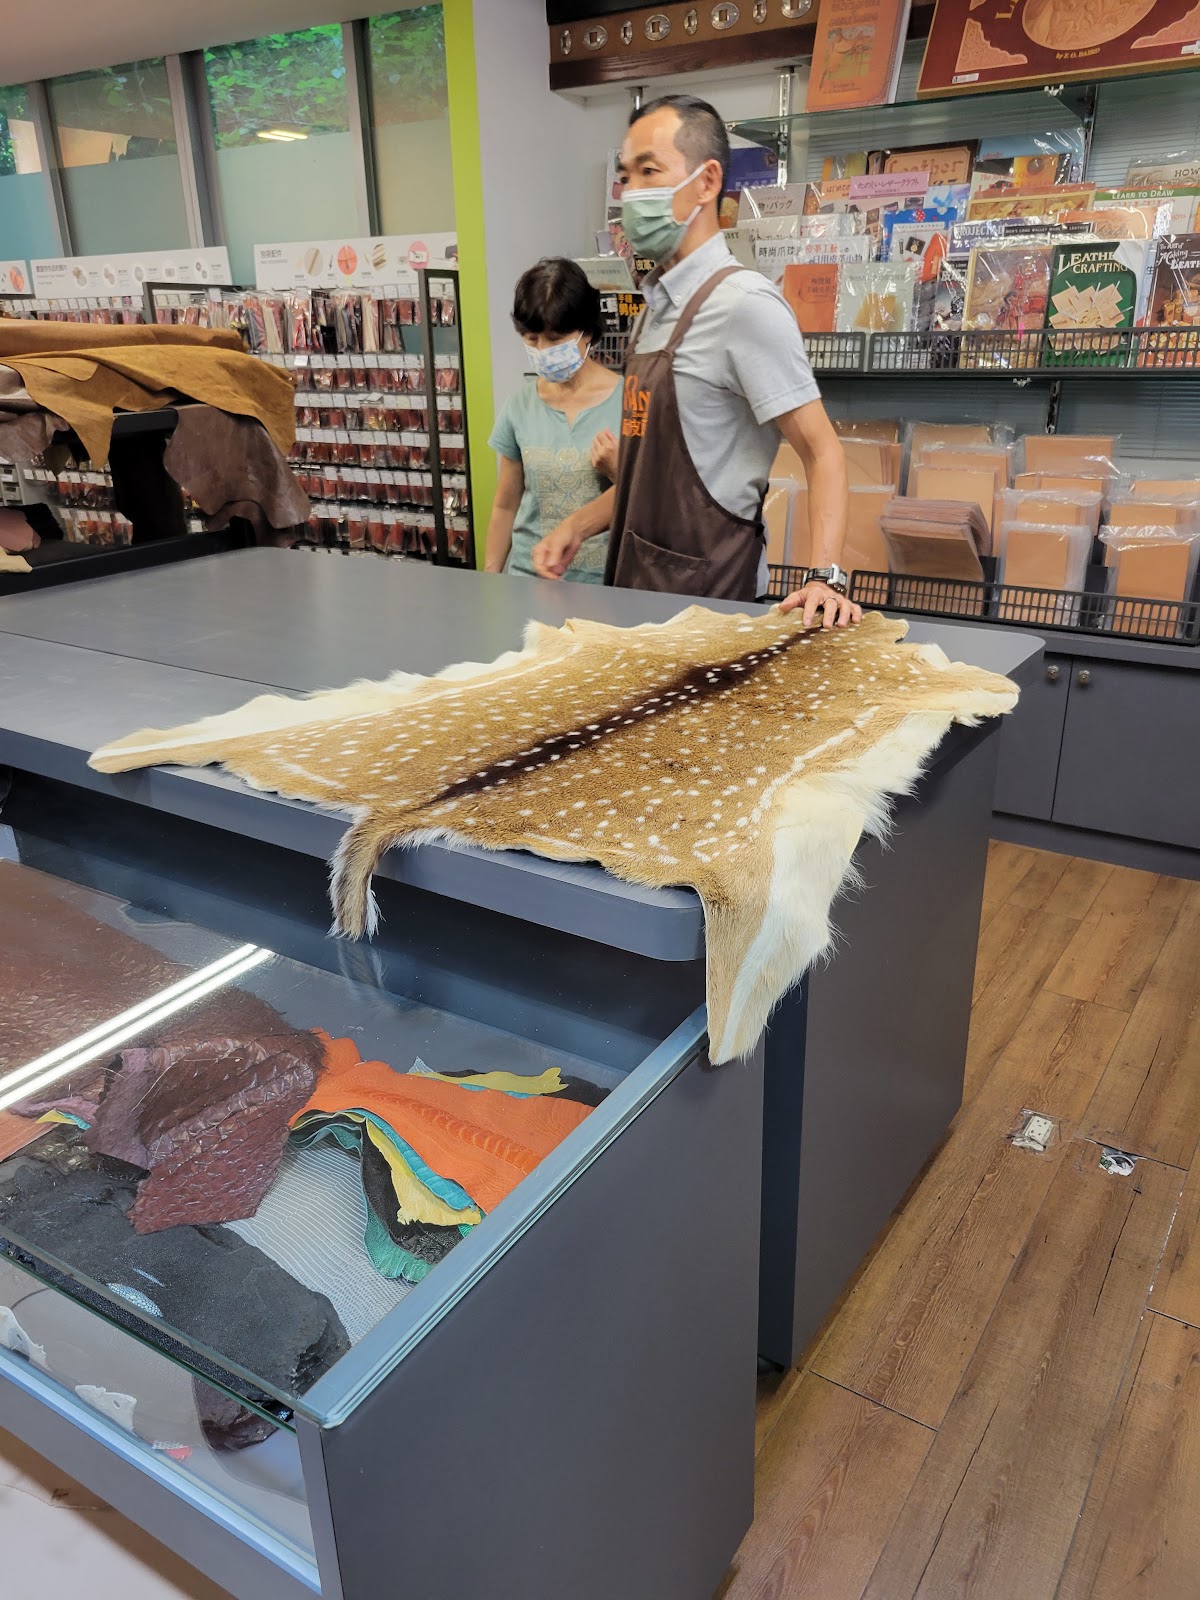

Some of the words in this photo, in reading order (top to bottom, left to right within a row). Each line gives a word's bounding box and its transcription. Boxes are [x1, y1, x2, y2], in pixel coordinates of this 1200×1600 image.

[1150, 189, 1174, 198] DRAW
[1057, 251, 1115, 276] LEATHE
[1072, 261, 1128, 275] CRAFTING
